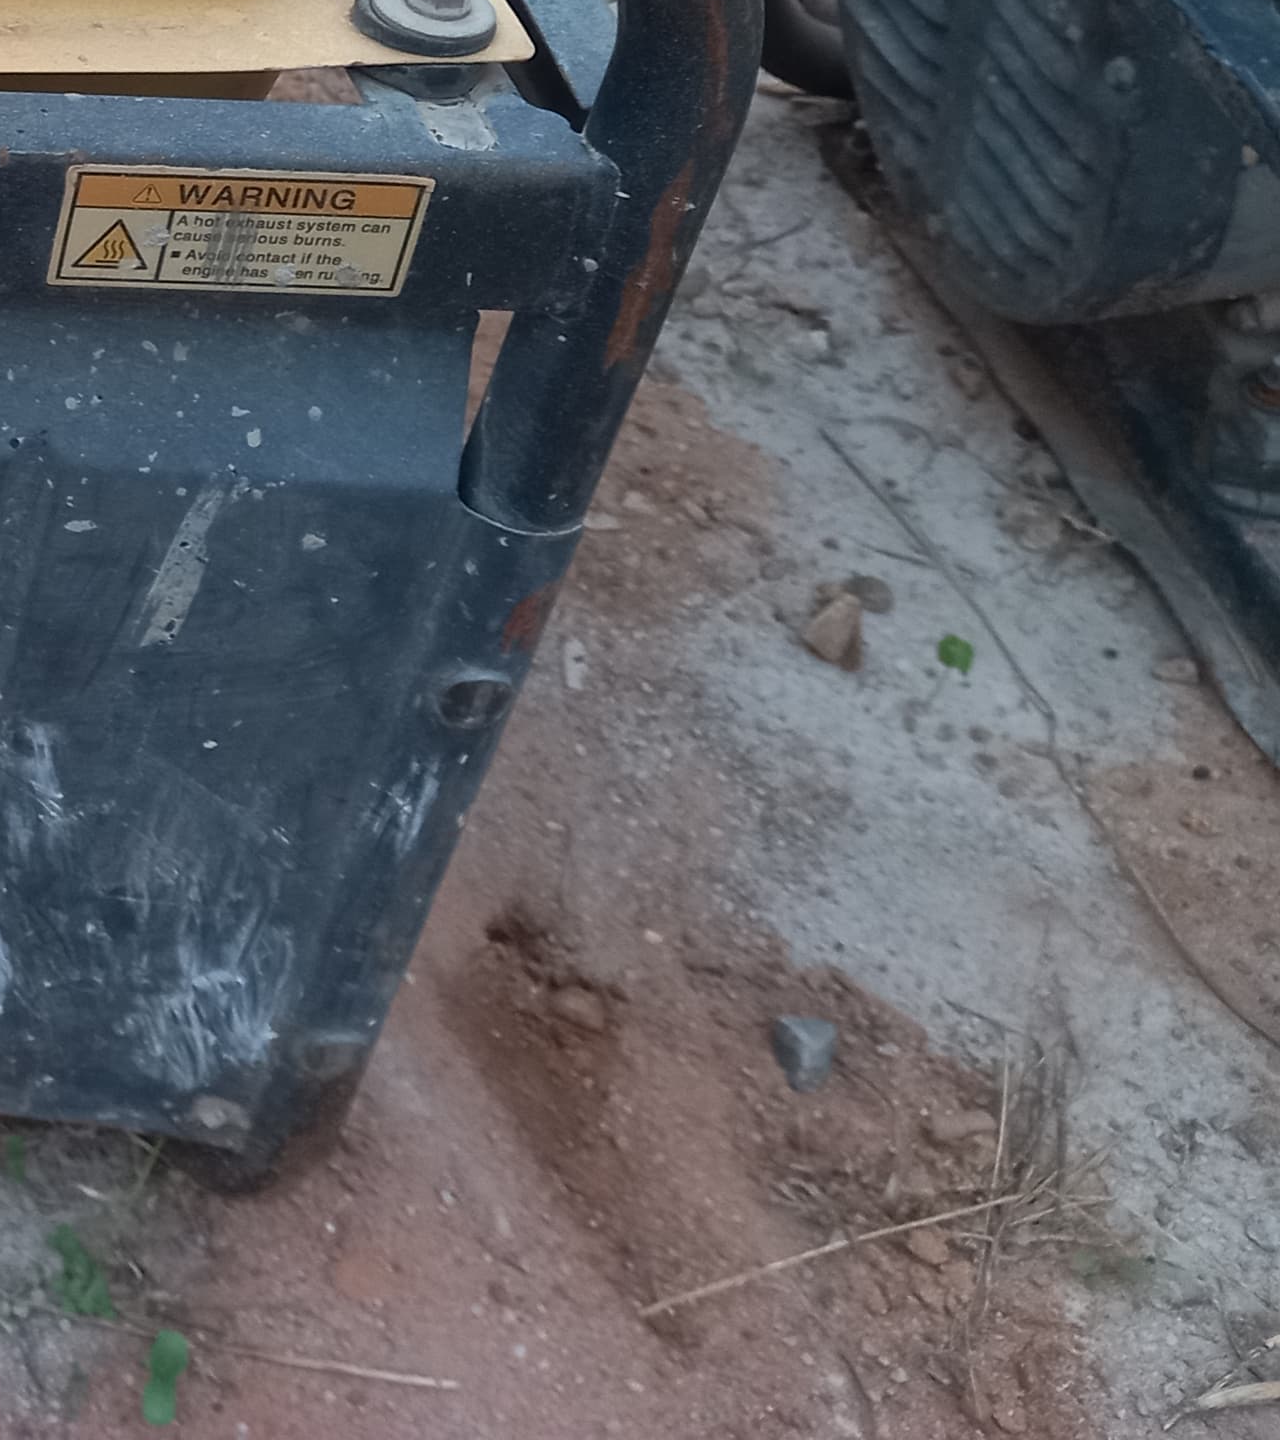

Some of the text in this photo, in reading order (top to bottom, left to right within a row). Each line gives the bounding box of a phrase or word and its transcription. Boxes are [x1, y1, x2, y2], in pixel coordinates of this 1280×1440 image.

[178, 183, 357, 211] WARNING
[176, 215, 391, 234] A hot exhaust system can
[293, 234, 346, 247] burns.
[237, 252, 297, 266] contact
[300, 253, 312, 265] if
[316, 254, 343, 266] the
[240, 266, 269, 278] has
